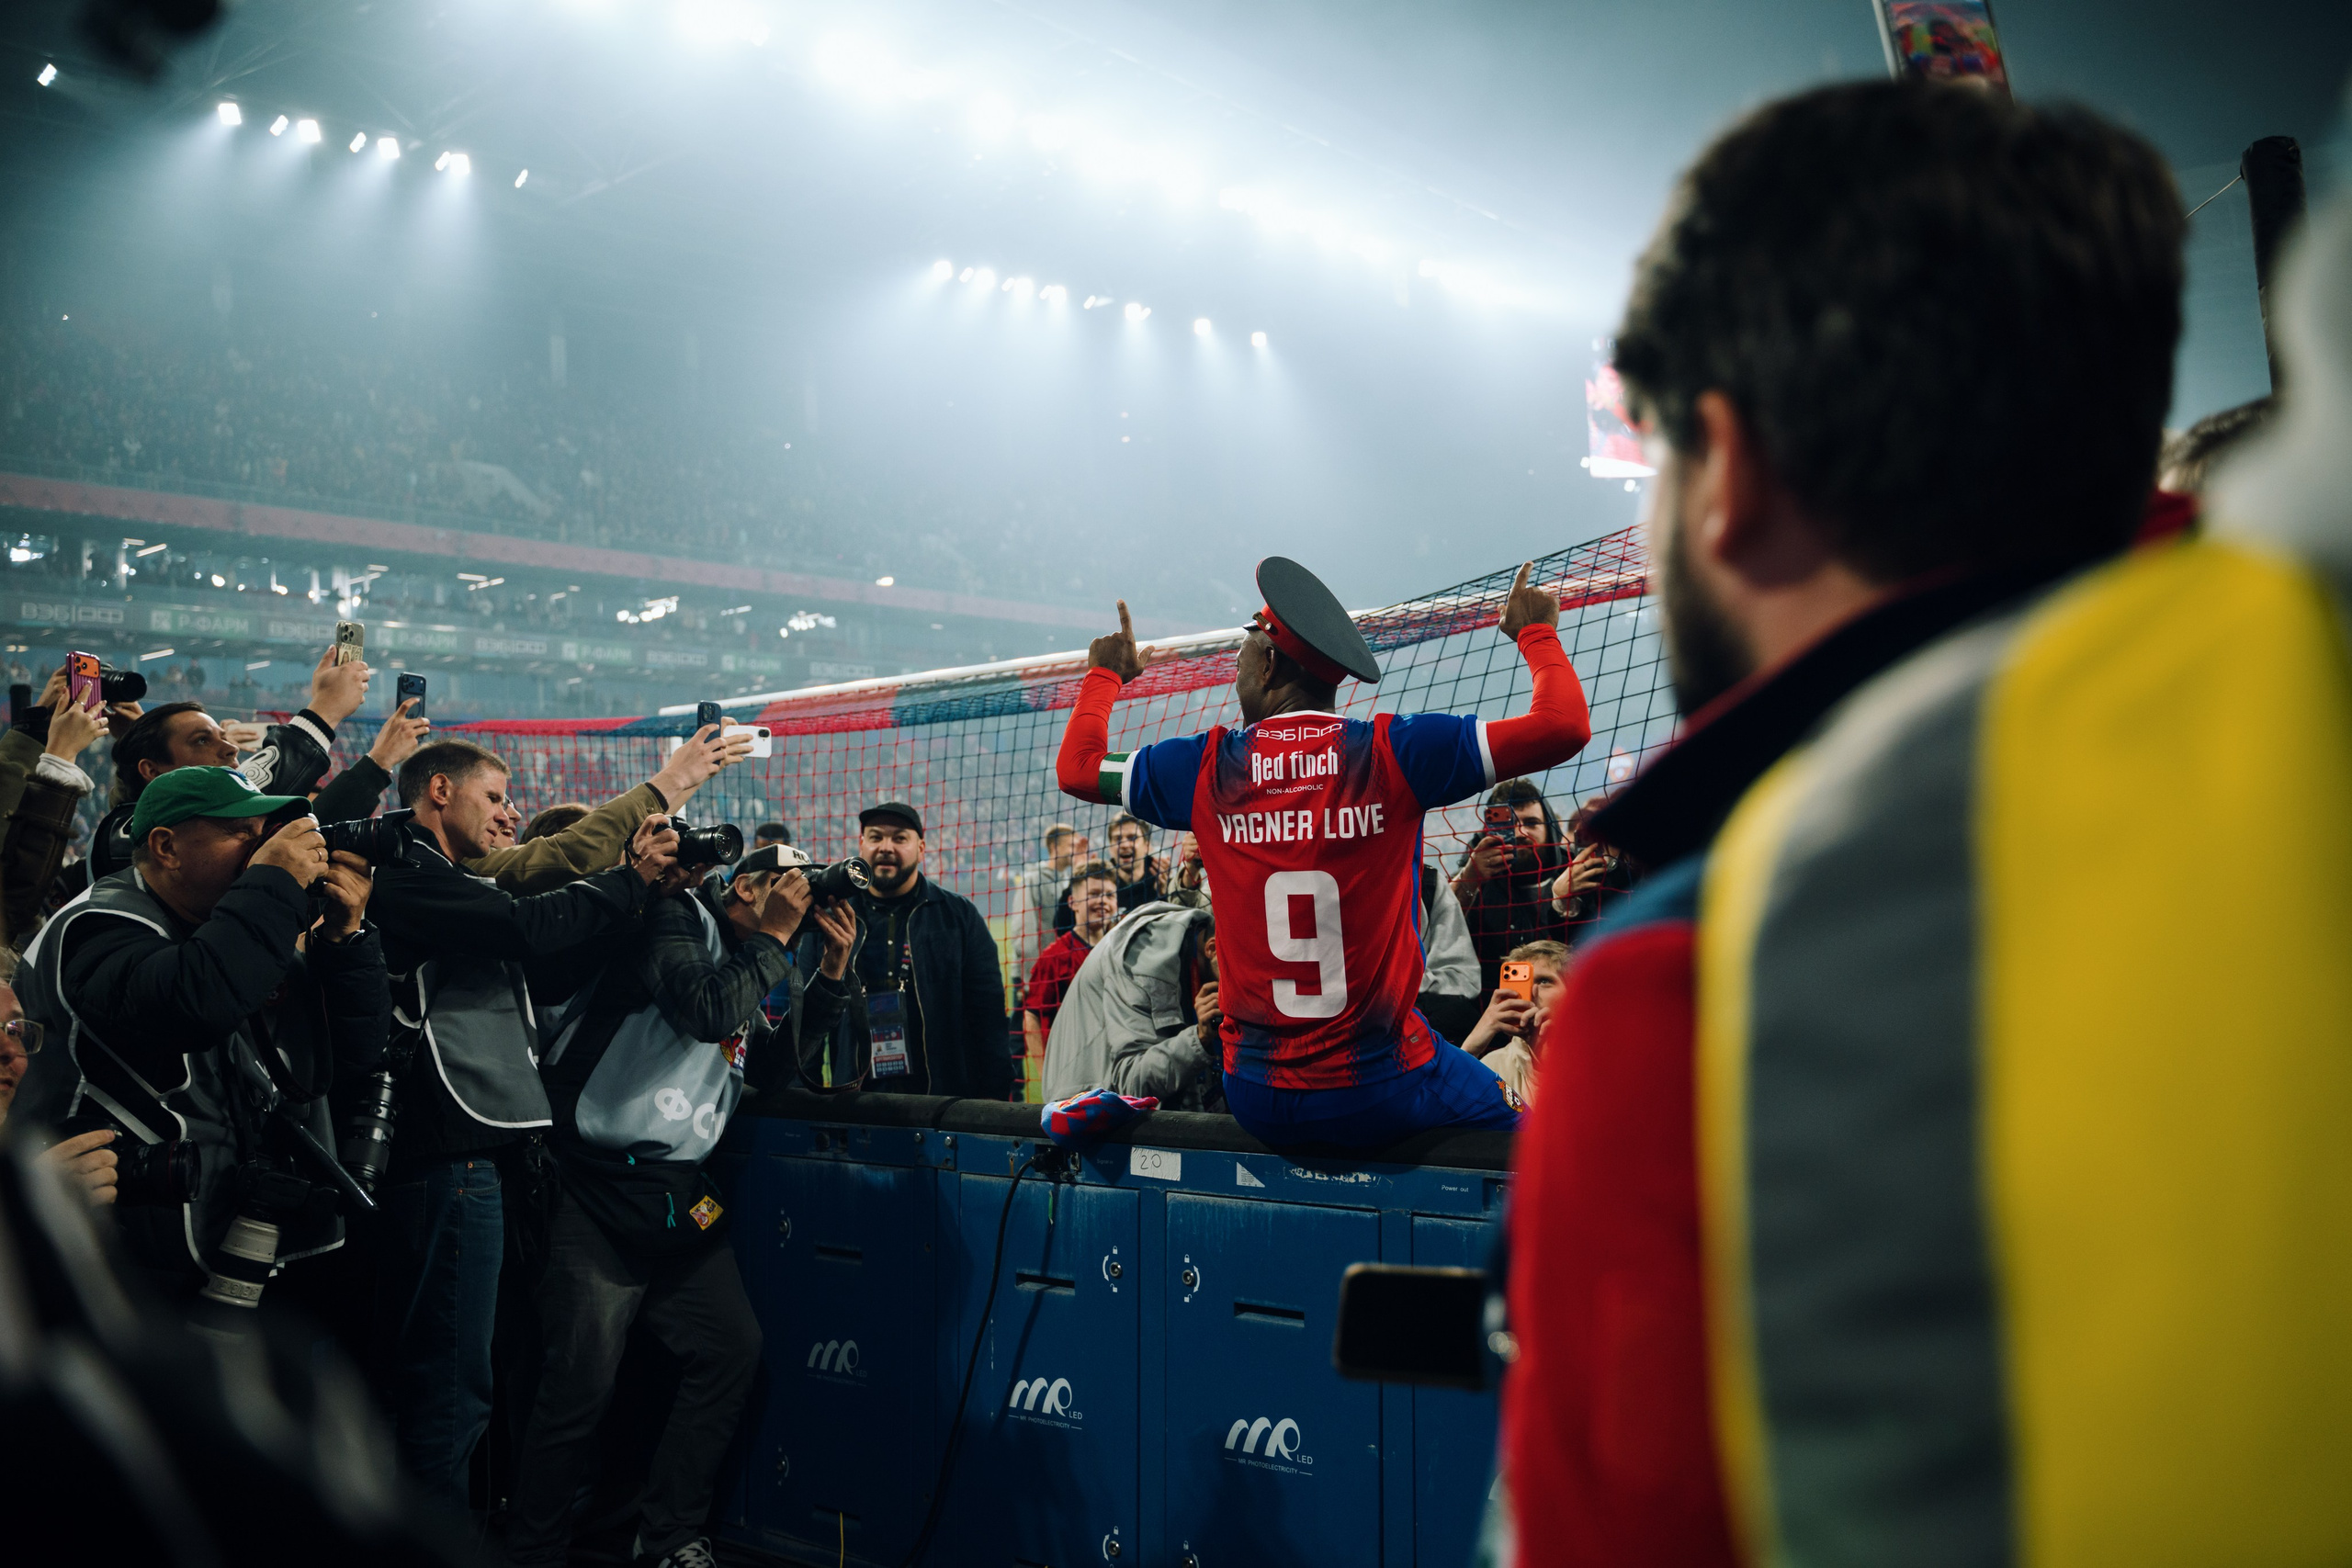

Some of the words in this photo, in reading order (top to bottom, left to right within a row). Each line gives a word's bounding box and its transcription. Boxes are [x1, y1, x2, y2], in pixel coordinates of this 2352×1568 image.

[1251, 751, 1284, 787] Red
[1288, 745, 1339, 780] finch
[1266, 784, 1324, 795] NON-ALCOHOLIC
[1217, 809, 1314, 843] VAGNER
[1324, 803, 1385, 839] LOVE
[1264, 870, 1348, 1019] 9
[1140, 1154, 1161, 1169] 20
[1069, 1410, 1083, 1420] LED
[1296, 1453, 1314, 1465] LED
[1248, 1460, 1298, 1474] PHOTOELECTRICITY
